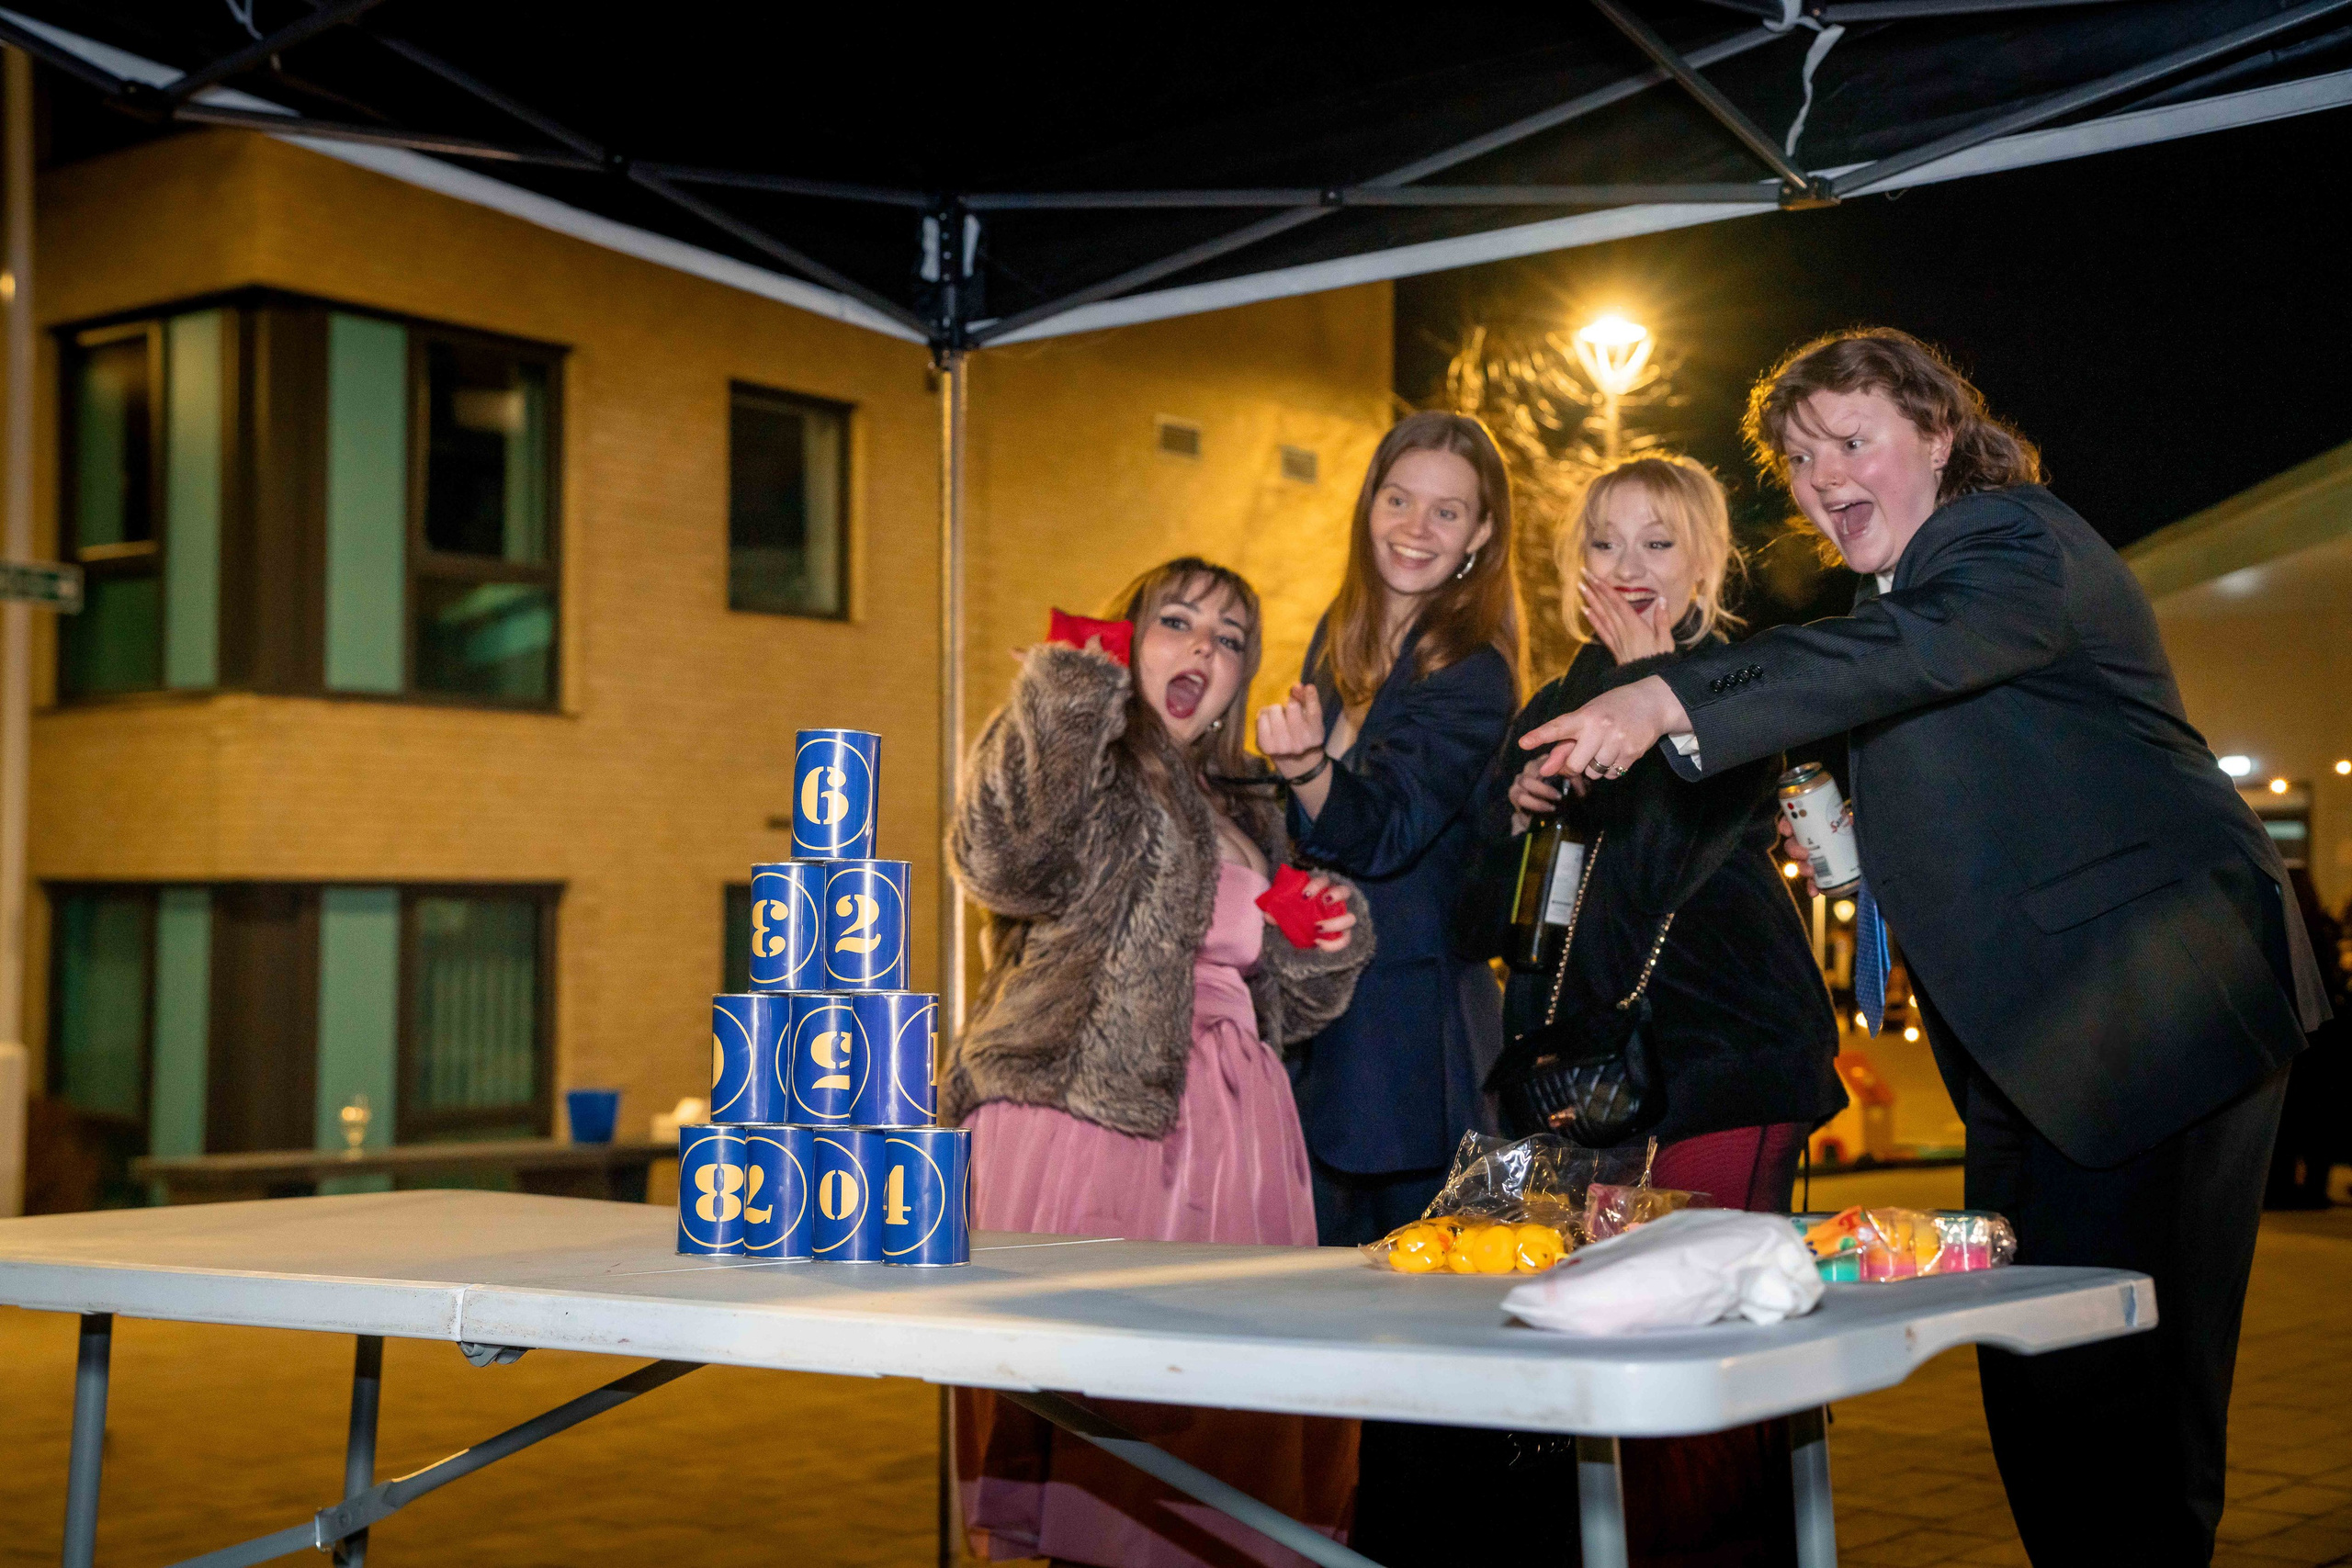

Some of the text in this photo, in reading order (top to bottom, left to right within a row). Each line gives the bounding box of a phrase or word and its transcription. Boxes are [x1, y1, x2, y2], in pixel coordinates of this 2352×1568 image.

[801, 766, 849, 825] 6
[834, 894, 882, 953] 2
[695, 1163, 744, 1223] 8
